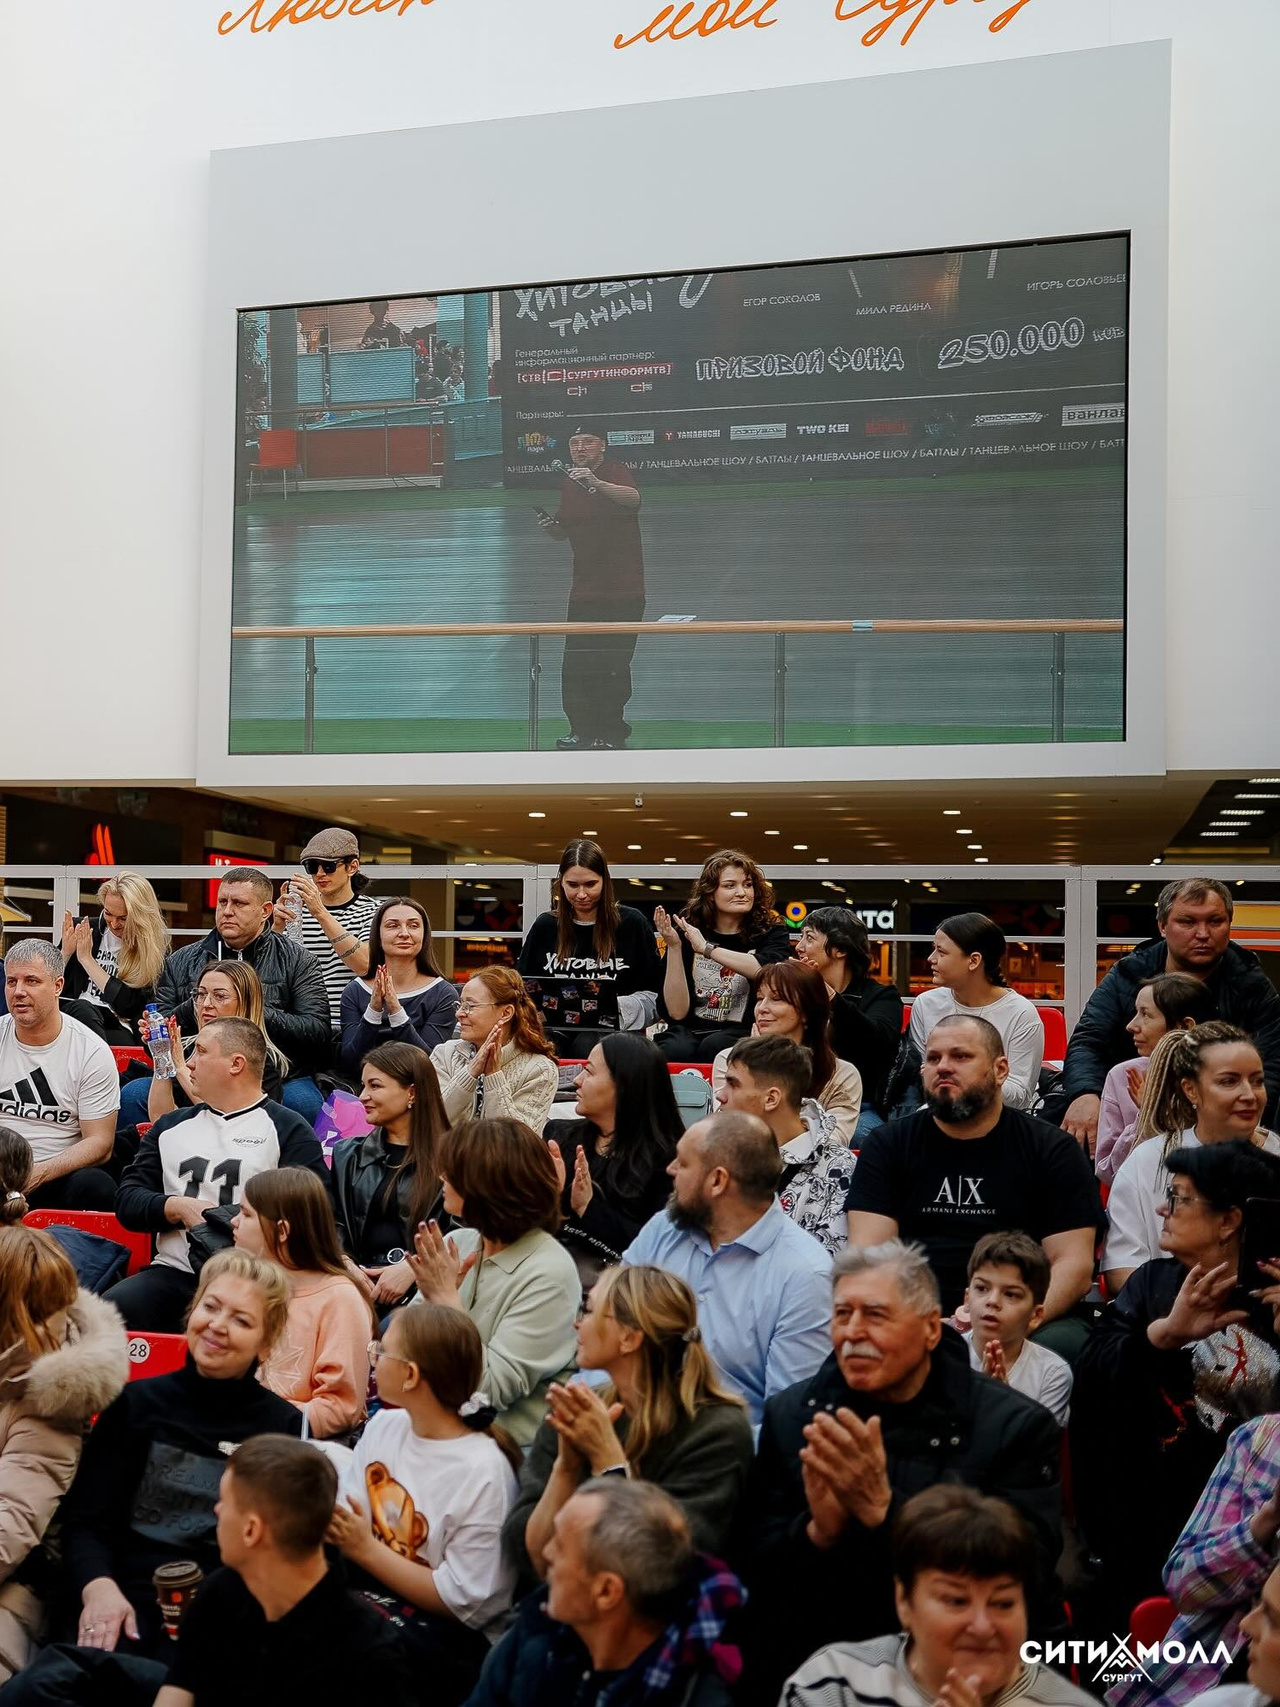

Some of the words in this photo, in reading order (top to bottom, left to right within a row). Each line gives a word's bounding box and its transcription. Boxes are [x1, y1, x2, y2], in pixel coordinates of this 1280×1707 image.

[1027, 279, 1063, 291] ИГОРЬ
[743, 297, 767, 307] ЕГОР
[769, 293, 821, 305] СОКОЛОВ
[549, 290, 653, 337] ТАНЦЫ
[515, 346, 578, 358] Генеральный
[696, 347, 825, 381] ПРИЗОВОЙ
[827, 346, 905, 373] ФОНД
[937, 316, 1086, 369] 250.000
[515, 353, 607, 367] информационный
[516, 410, 565, 420] Партнеры:
[677, 429, 721, 439] YAMAGUCHI
[797, 425, 826, 435] TWO
[828, 423, 850, 433] KEI
[646, 456, 720, 470] ТАНЦЕВАЛЬНОЕ
[721, 456, 747, 466] ШОУ
[756, 454, 792, 465] БАТТЛЫ
[801, 450, 881, 463] ТАНЦЕВАЛЬНОЕ
[883, 449, 909, 459] ШОУ
[920, 447, 959, 458] БАТТЛЫ
[969, 442, 1057, 455] ТАНЦЕВАЛЬНОЕ
[1059, 440, 1089, 451] ШОУ
[921, 1206, 953, 1214] ARMANI
[130, 1343, 147, 1358] 28
